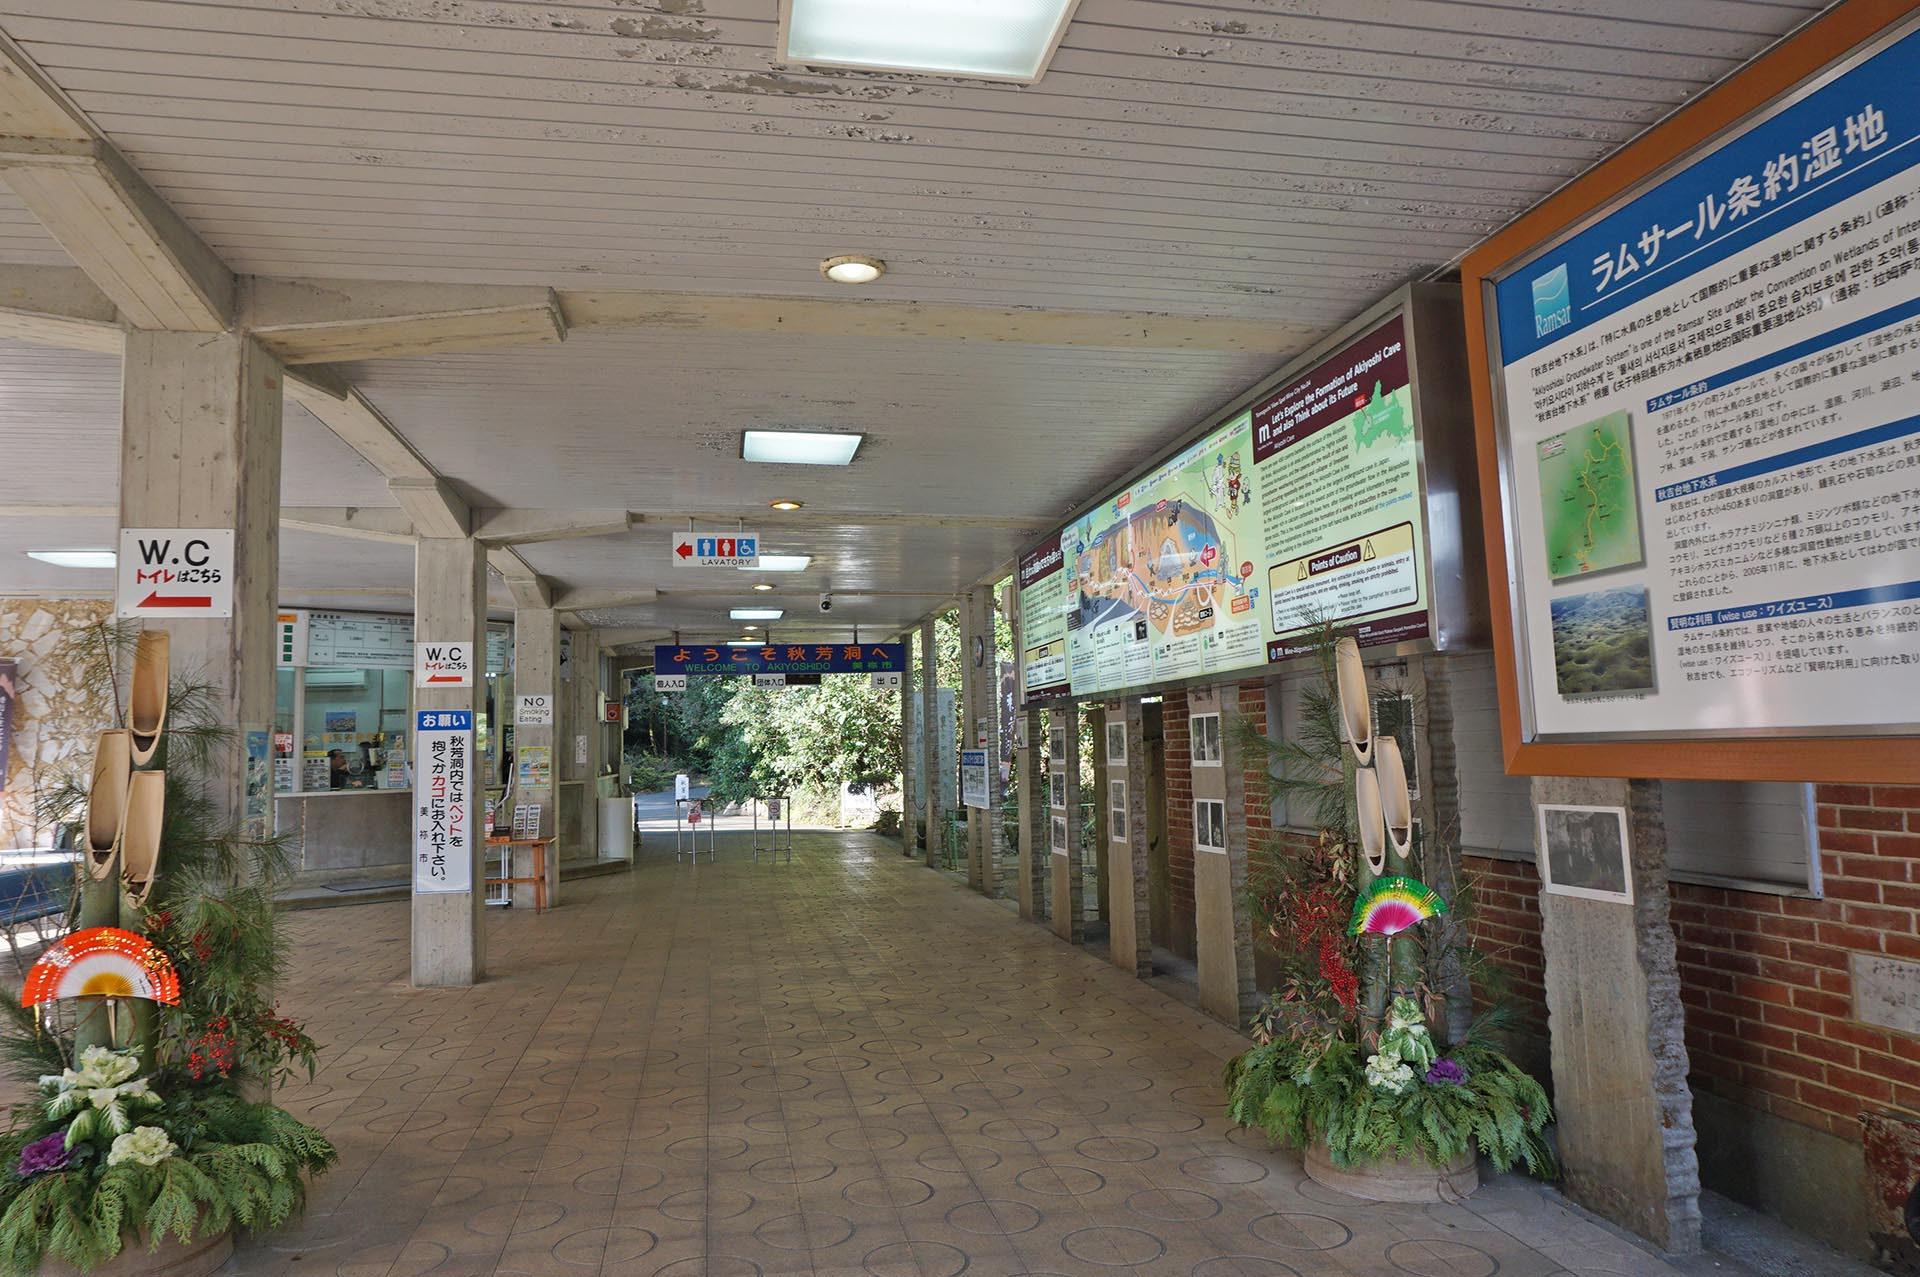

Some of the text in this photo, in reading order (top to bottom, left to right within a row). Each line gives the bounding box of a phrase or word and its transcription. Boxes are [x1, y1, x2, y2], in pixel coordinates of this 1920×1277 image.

[1592, 105, 1887, 291] ラムサール条約湿地
[1757, 294, 1787, 317] 중요한
[1849, 257, 1873, 278] 관한
[1565, 360, 1603, 382] Groundwater
[1632, 344, 1638, 353] is
[1640, 339, 1652, 350] one
[1654, 332, 1661, 344] of
[1663, 329, 1675, 339] the
[1677, 316, 1704, 334] Ramsar
[1707, 308, 1722, 320] Site
[1725, 297, 1747, 313] under
[1750, 289, 1763, 301] the
[1767, 266, 1816, 294] Convention
[1819, 259, 1831, 271] on
[1833, 237, 1879, 264] Wetlands
[1882, 228, 1893, 243] of
[1536, 303, 1571, 339] Ramsar
[1271, 342, 1400, 424] Let's Explore the Formation of Akiyoshi Cave
[1648, 379, 1709, 412] ラムサール条約
[1272, 382, 1357, 436] and also Think about its Future
[1285, 434, 1294, 442] Cave
[1658, 474, 1717, 500] 秋吉台地下水系
[138, 539, 210, 566] W.C
[1311, 550, 1357, 571] Points of Caution
[136, 568, 221, 584] トイレはこちら
[1673, 586, 1732, 601] に登録されました。
[426, 648, 462, 661] W.C
[673, 647, 889, 661] ようこそ秋芳洞へ
[425, 662, 467, 670] トイレはこちら
[685, 662, 831, 672] WELCOME TO AKIYOSHIDO
[656, 680, 685, 689] 個人入口
[756, 679, 785, 687] 団体入口
[524, 698, 545, 706] NO
[423, 713, 465, 727] お願い
[519, 708, 549, 717] Smoking
[519, 715, 542, 724] Eating
[449, 735, 464, 848] 秋芳洞内ではペットを
[431, 740, 447, 882] 抱くかカゴにお入れ下さい。
